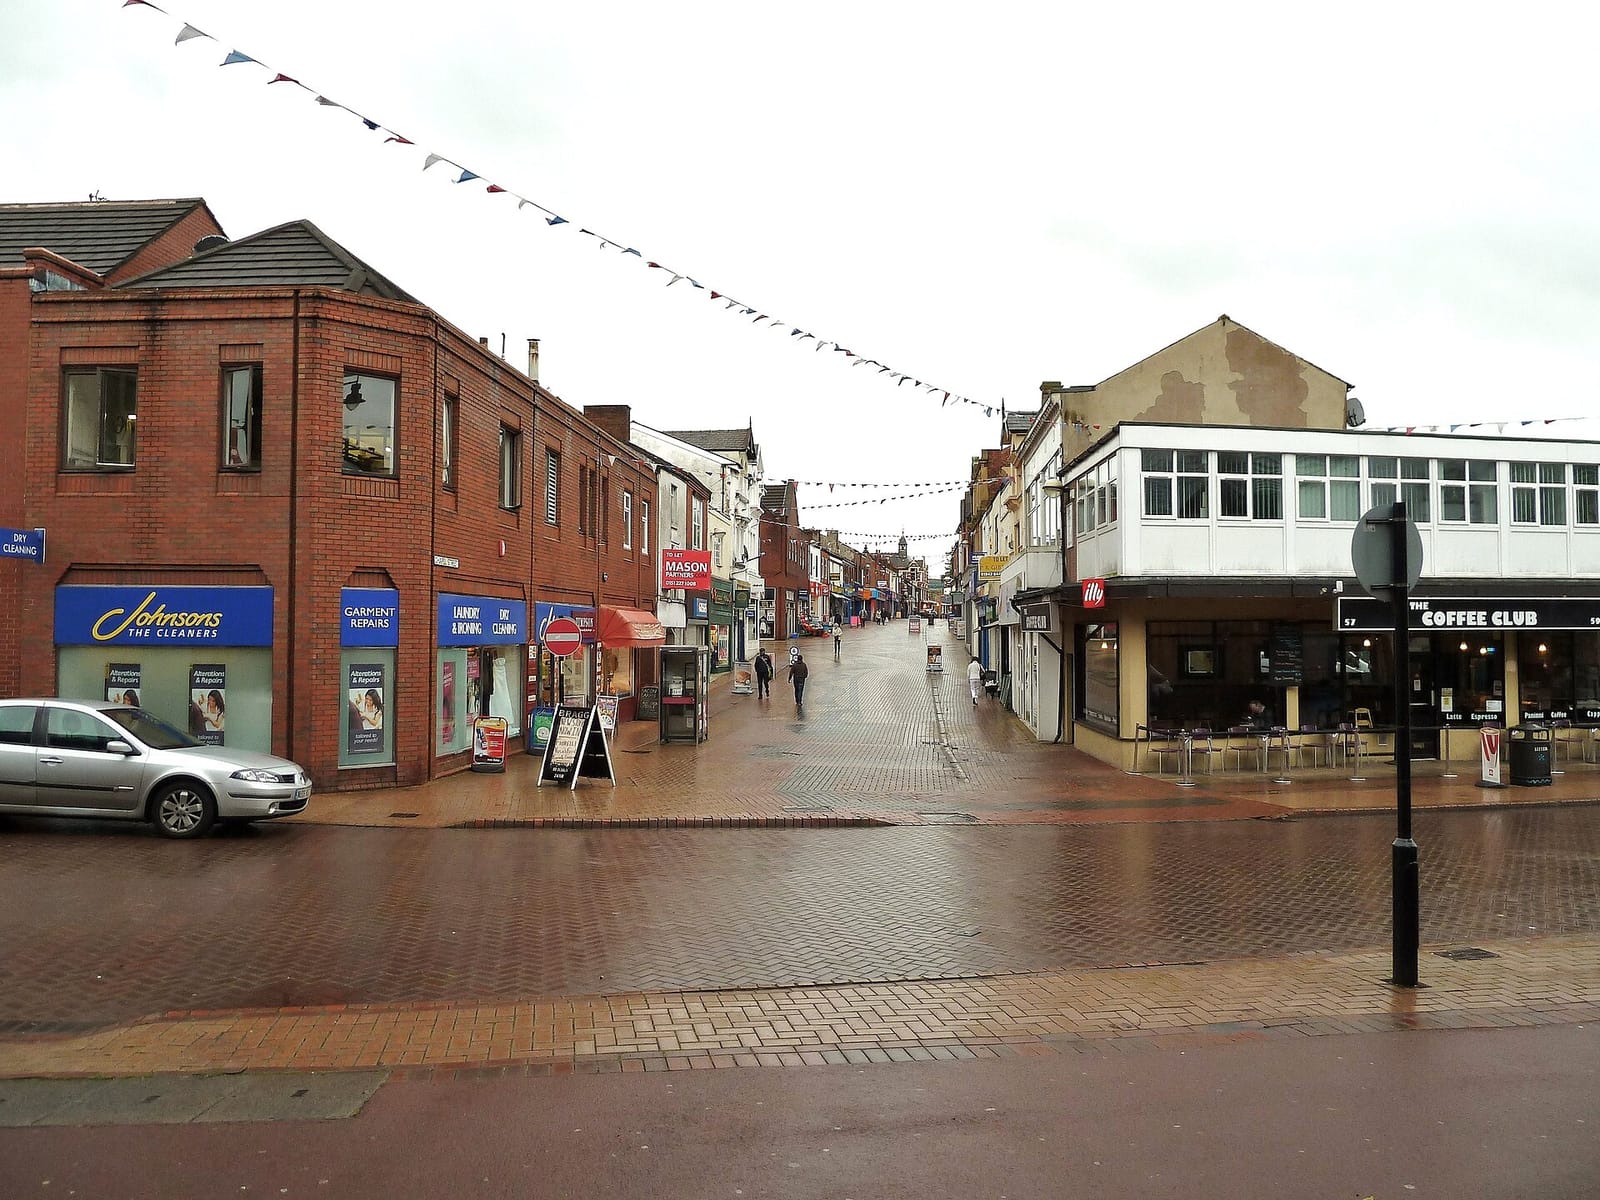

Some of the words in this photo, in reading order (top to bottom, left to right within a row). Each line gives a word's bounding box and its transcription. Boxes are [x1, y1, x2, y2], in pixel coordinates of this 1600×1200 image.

[13, 533, 27, 543] DRY
[3, 544, 37, 556] CLEANING
[665, 561, 708, 572] MASON
[1085, 582, 1103, 605] illy
[1409, 601, 1429, 610] THE
[92, 591, 223, 640] Johnsons
[344, 607, 396, 617] GARMENT
[453, 606, 481, 619] LAUNDRY
[499, 609, 510, 620] DRY
[350, 619, 390, 628] REPAIRS
[1344, 618, 1356, 626] 57
[1421, 611, 1487, 626] COFFEE
[1491, 611, 1537, 626] CLUB
[128, 628, 151, 637] THE
[156, 628, 218, 638] CLEANERS
[452, 622, 457, 634] &
[457, 623, 482, 635] IRONING
[492, 623, 517, 635] CLEANING
[358, 677, 380, 685] Repairs
[1471, 712, 1498, 721] Espresso
